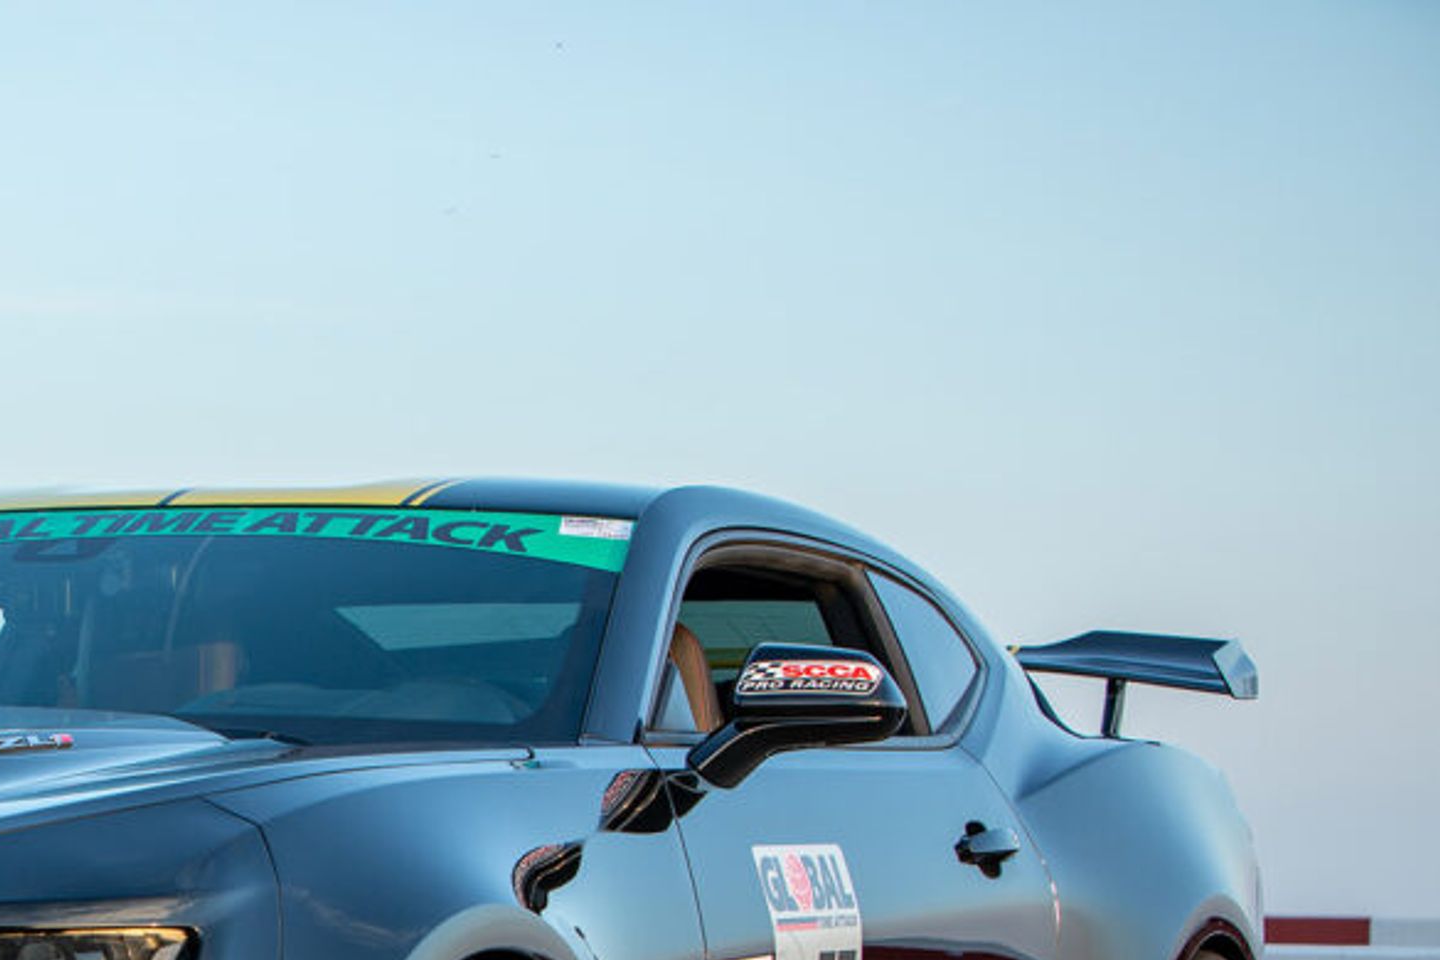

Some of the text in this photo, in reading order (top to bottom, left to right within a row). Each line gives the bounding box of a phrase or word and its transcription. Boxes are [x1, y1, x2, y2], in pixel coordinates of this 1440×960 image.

[71, 511, 248, 534] TIME
[242, 511, 545, 553] ATTACK
[780, 664, 874, 681] SCCA
[741, 680, 870, 692] PRO RACING
